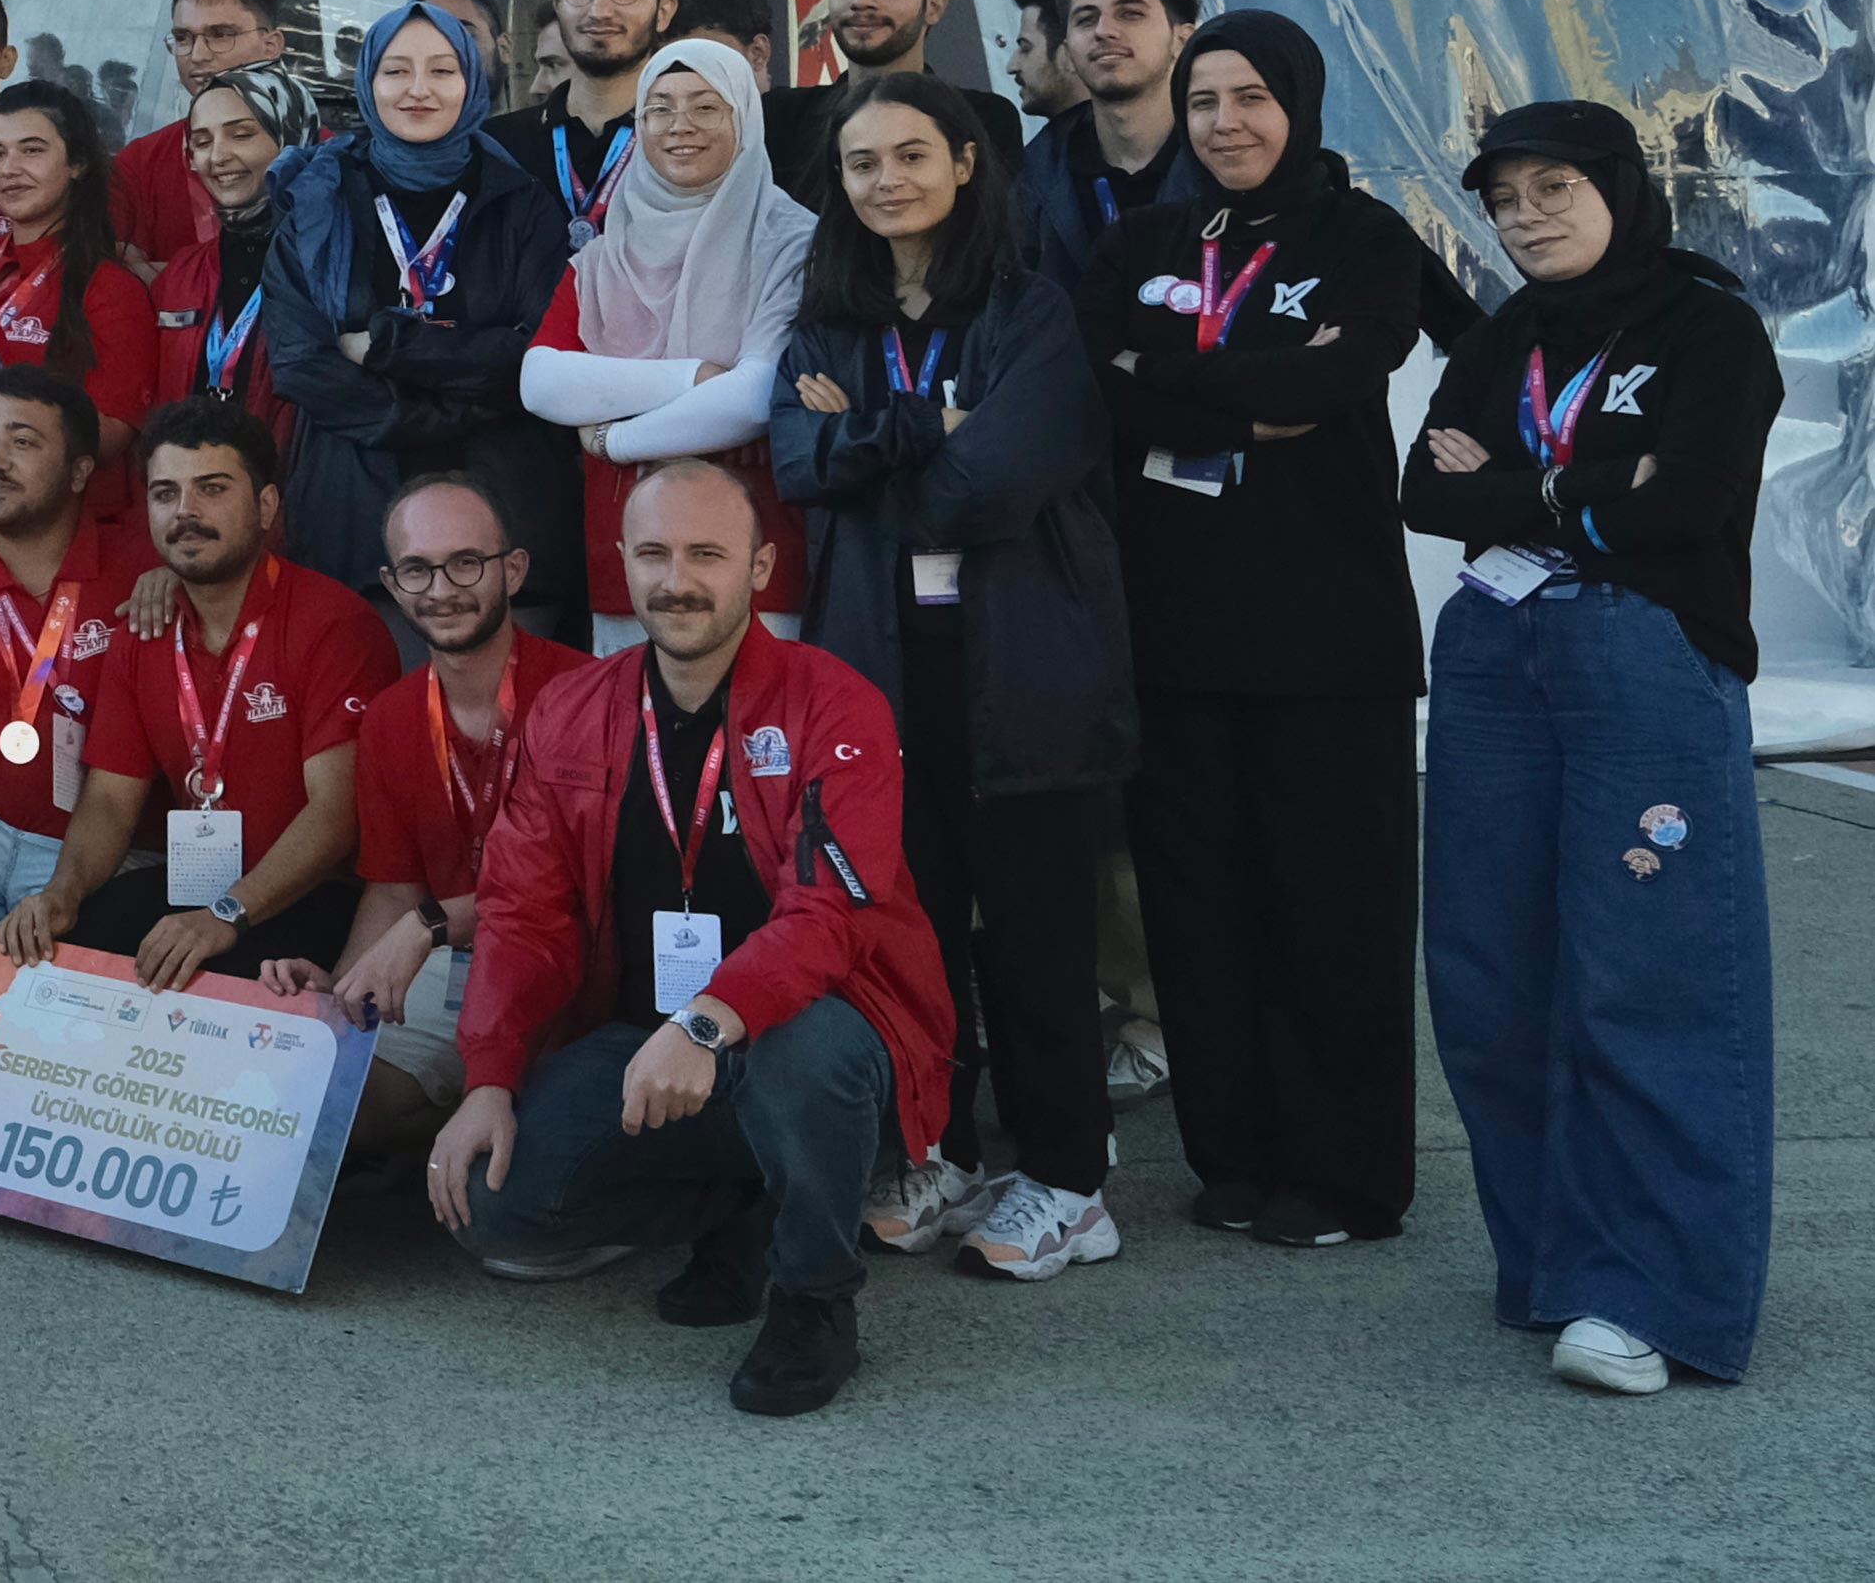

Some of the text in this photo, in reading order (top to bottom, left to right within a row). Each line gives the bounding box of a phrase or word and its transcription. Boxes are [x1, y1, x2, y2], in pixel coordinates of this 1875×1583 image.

[125, 1045, 186, 1078] 2025
[92, 1072, 169, 1108] GÖREV
[168, 1090, 302, 1139] KATEGORİSİ
[164, 1122, 242, 1163] ÖDÜLÜ
